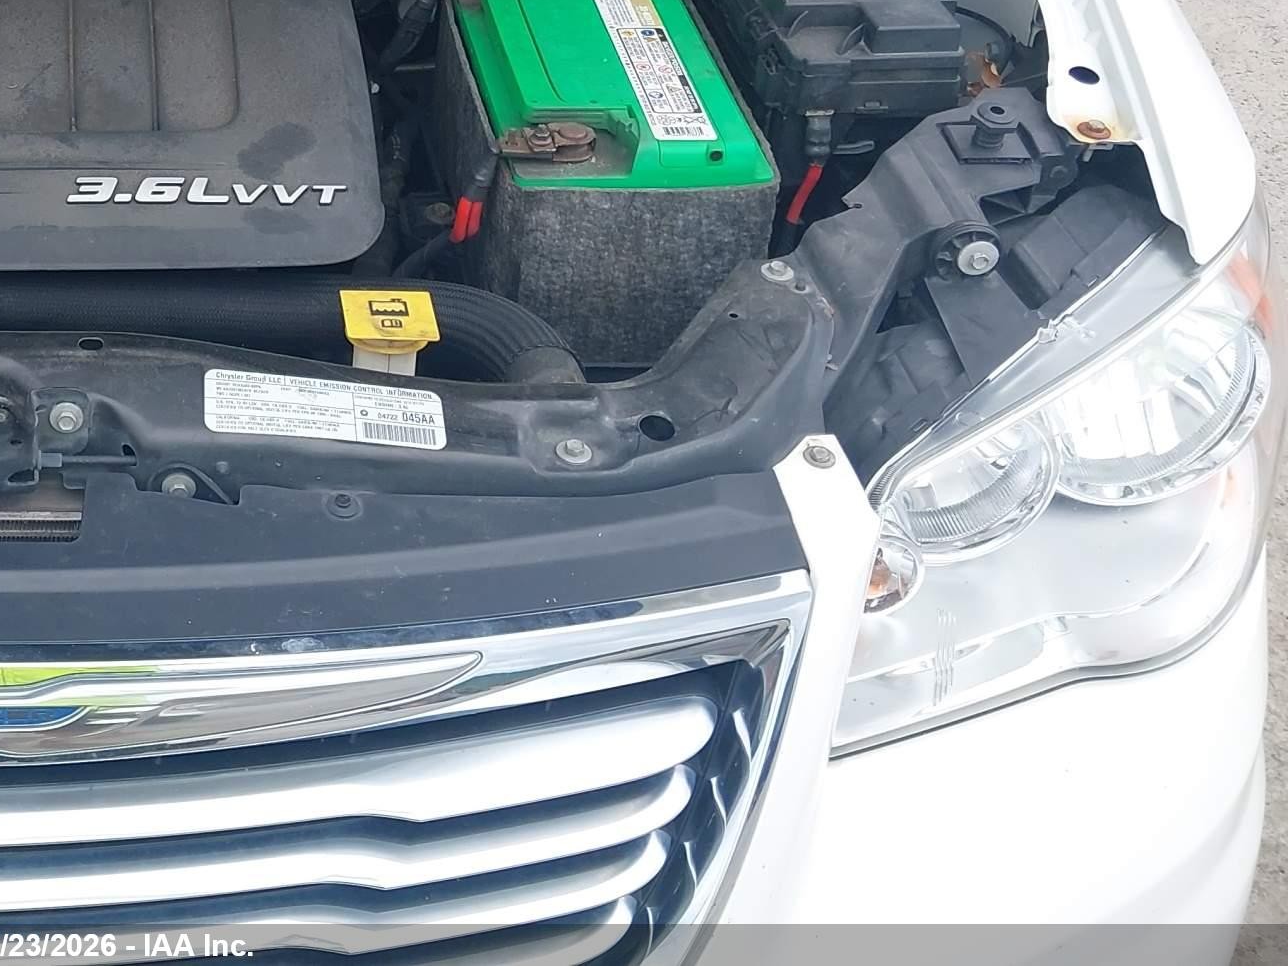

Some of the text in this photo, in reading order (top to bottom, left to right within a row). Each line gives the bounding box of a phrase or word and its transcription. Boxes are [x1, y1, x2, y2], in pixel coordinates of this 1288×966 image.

[66, 176, 348, 205] 3.6L VVT
[215, 371, 244, 381] Chrysler
[245, 374, 267, 383] Group
[289, 379, 317, 387] VEHICLE
[319, 382, 351, 391] EMISSION
[353, 385, 383, 395] CONTROL
[386, 388, 433, 400] INFORMATION
